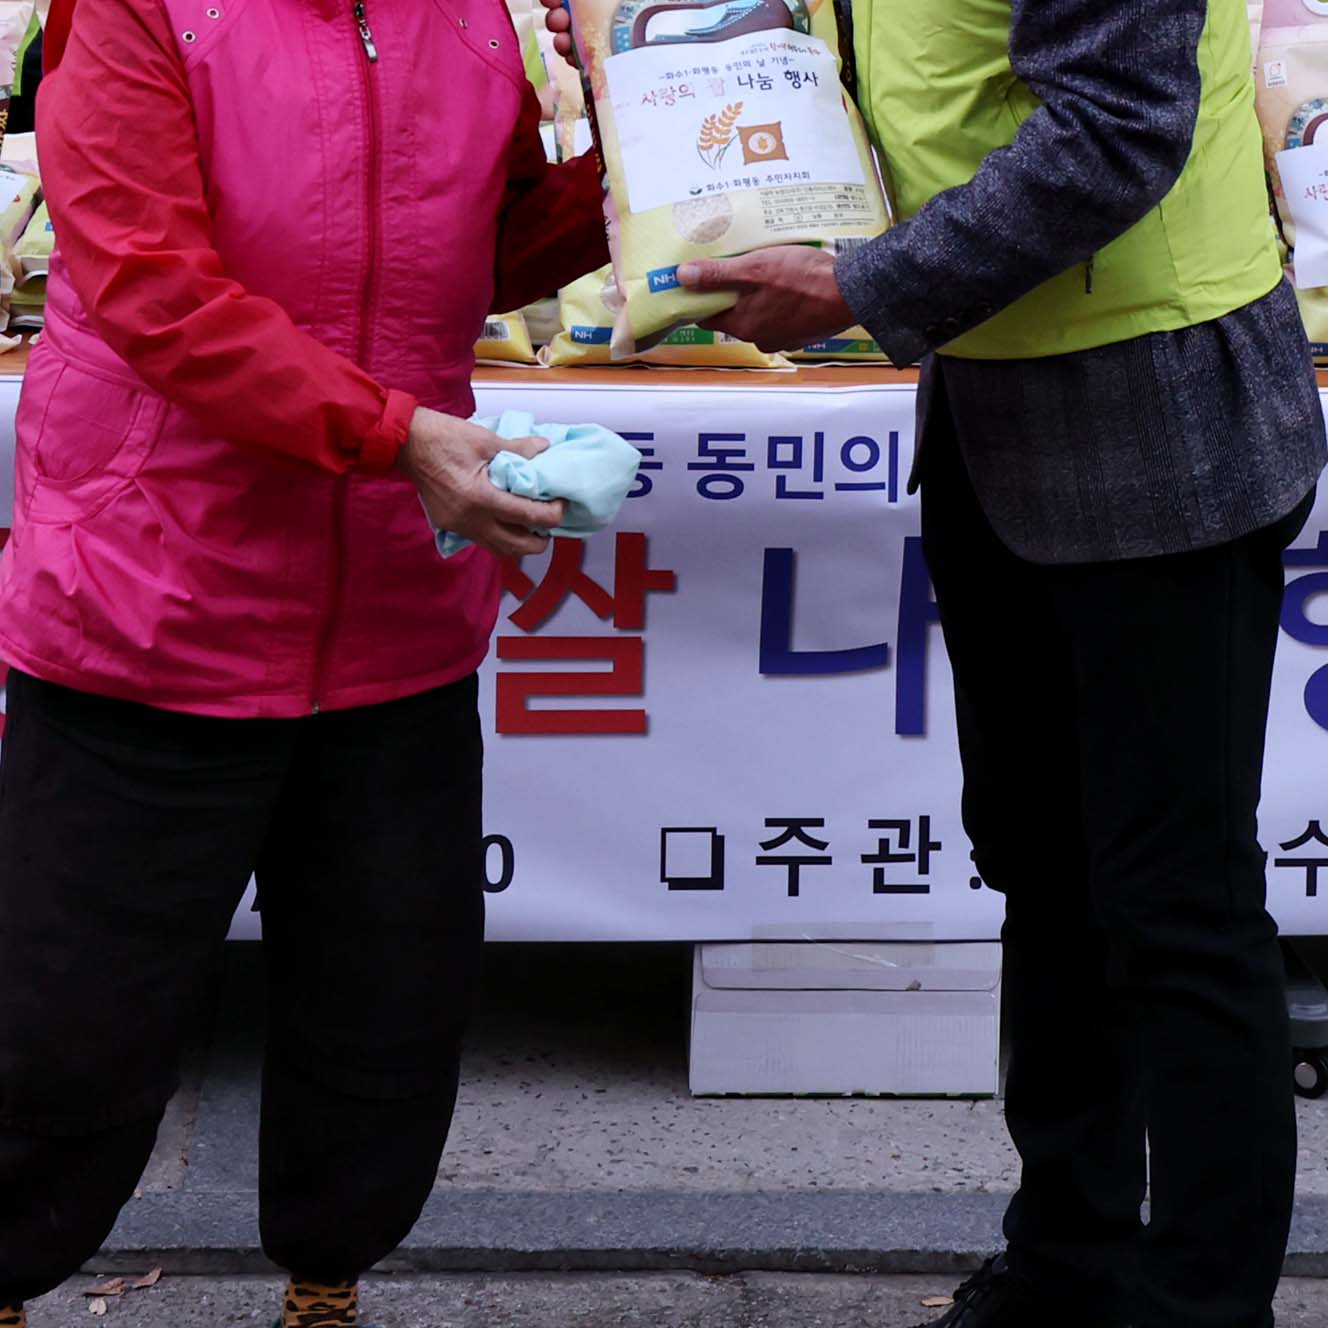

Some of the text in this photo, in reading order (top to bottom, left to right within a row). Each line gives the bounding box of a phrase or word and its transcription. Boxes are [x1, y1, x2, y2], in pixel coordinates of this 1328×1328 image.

[737, 73, 773, 91] 나눔
[784, 70, 820, 90] 행사
[687, 431, 900, 504] 동민의
[496, 532, 677, 735] 쌀
